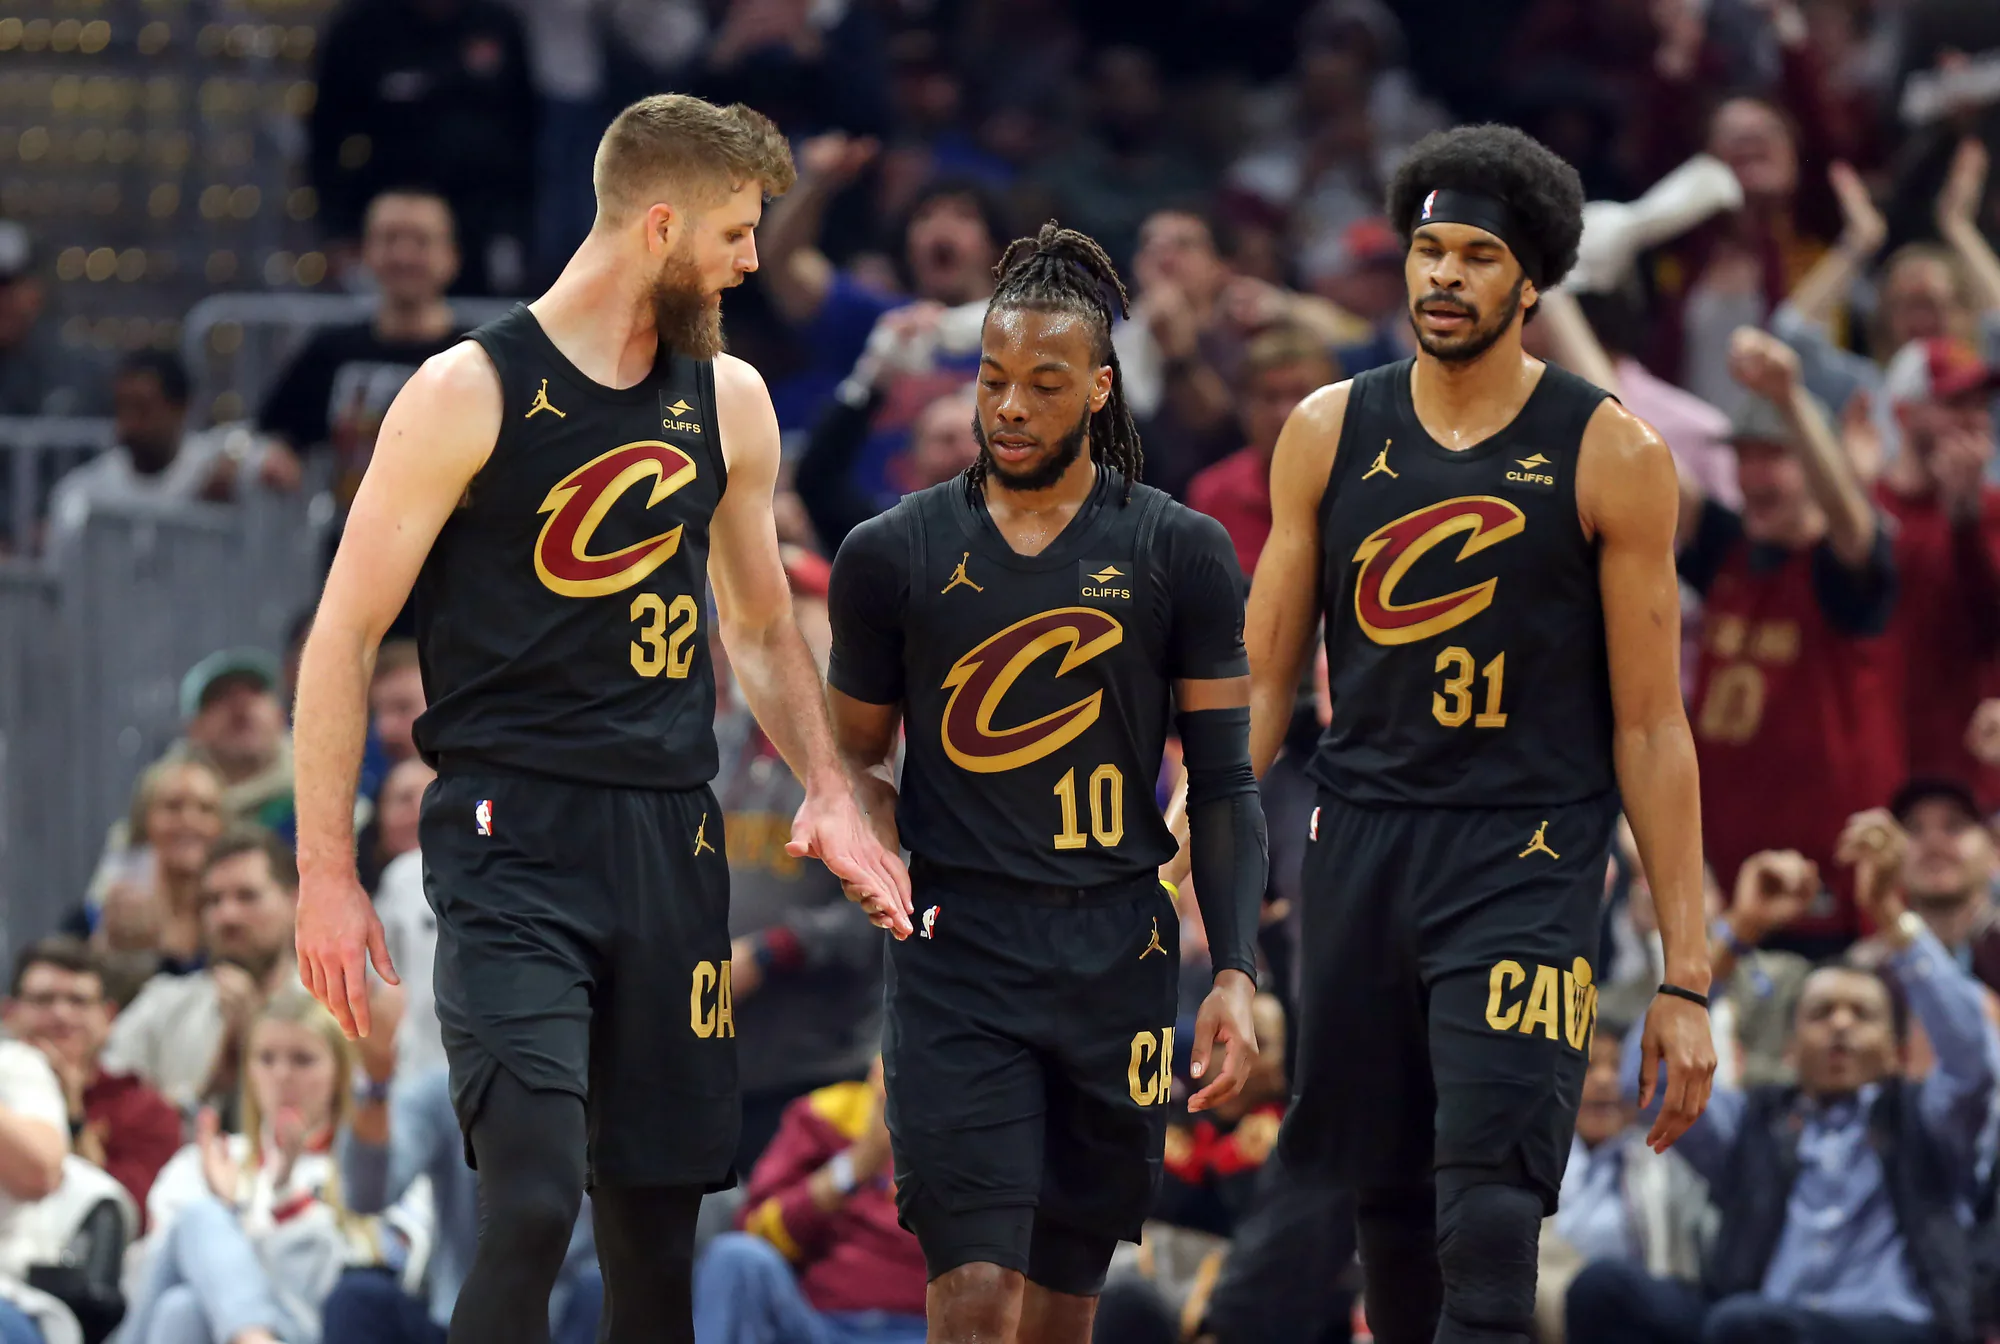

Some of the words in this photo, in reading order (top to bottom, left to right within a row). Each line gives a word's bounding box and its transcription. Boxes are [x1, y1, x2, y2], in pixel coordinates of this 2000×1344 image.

[663, 418, 701, 433] CLIFFS
[534, 440, 697, 598] C
[1506, 471, 1554, 485] CLIFFS
[1082, 586, 1130, 599] CLIFFS
[1352, 495, 1526, 646] C
[630, 592, 698, 679] 32
[940, 606, 1123, 773] C
[1432, 645, 1508, 728] 31
[1053, 763, 1124, 850] 10
[1485, 956, 1599, 1063] CAV
[1128, 1026, 1176, 1107] CA
